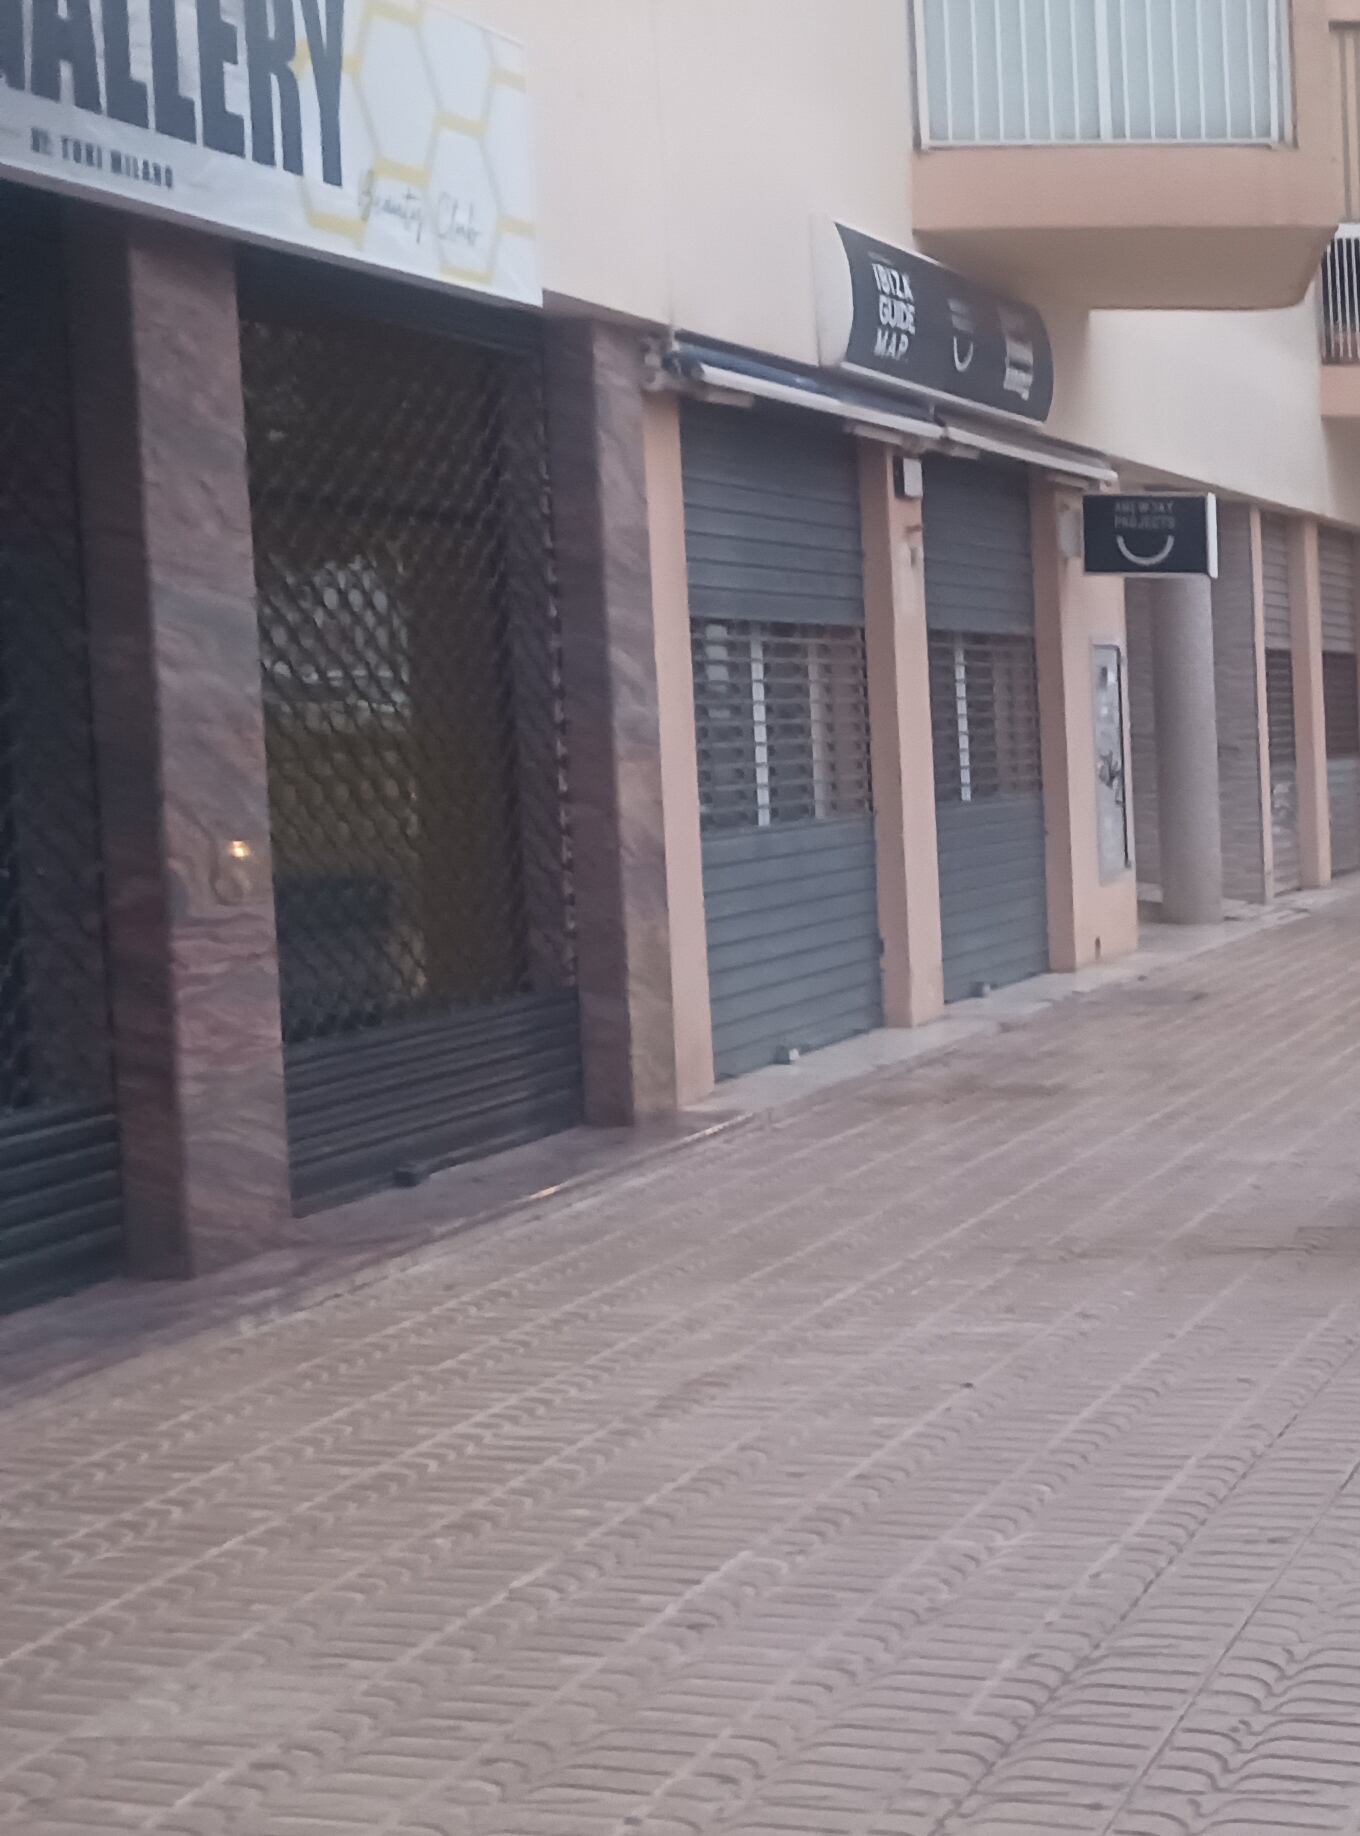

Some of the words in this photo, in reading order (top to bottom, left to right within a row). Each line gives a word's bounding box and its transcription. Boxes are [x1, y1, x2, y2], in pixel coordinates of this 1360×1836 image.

[0, 0, 343, 187] ALLERY
[879, 294, 915, 336] GUIDE
[873, 327, 909, 361] MAP
